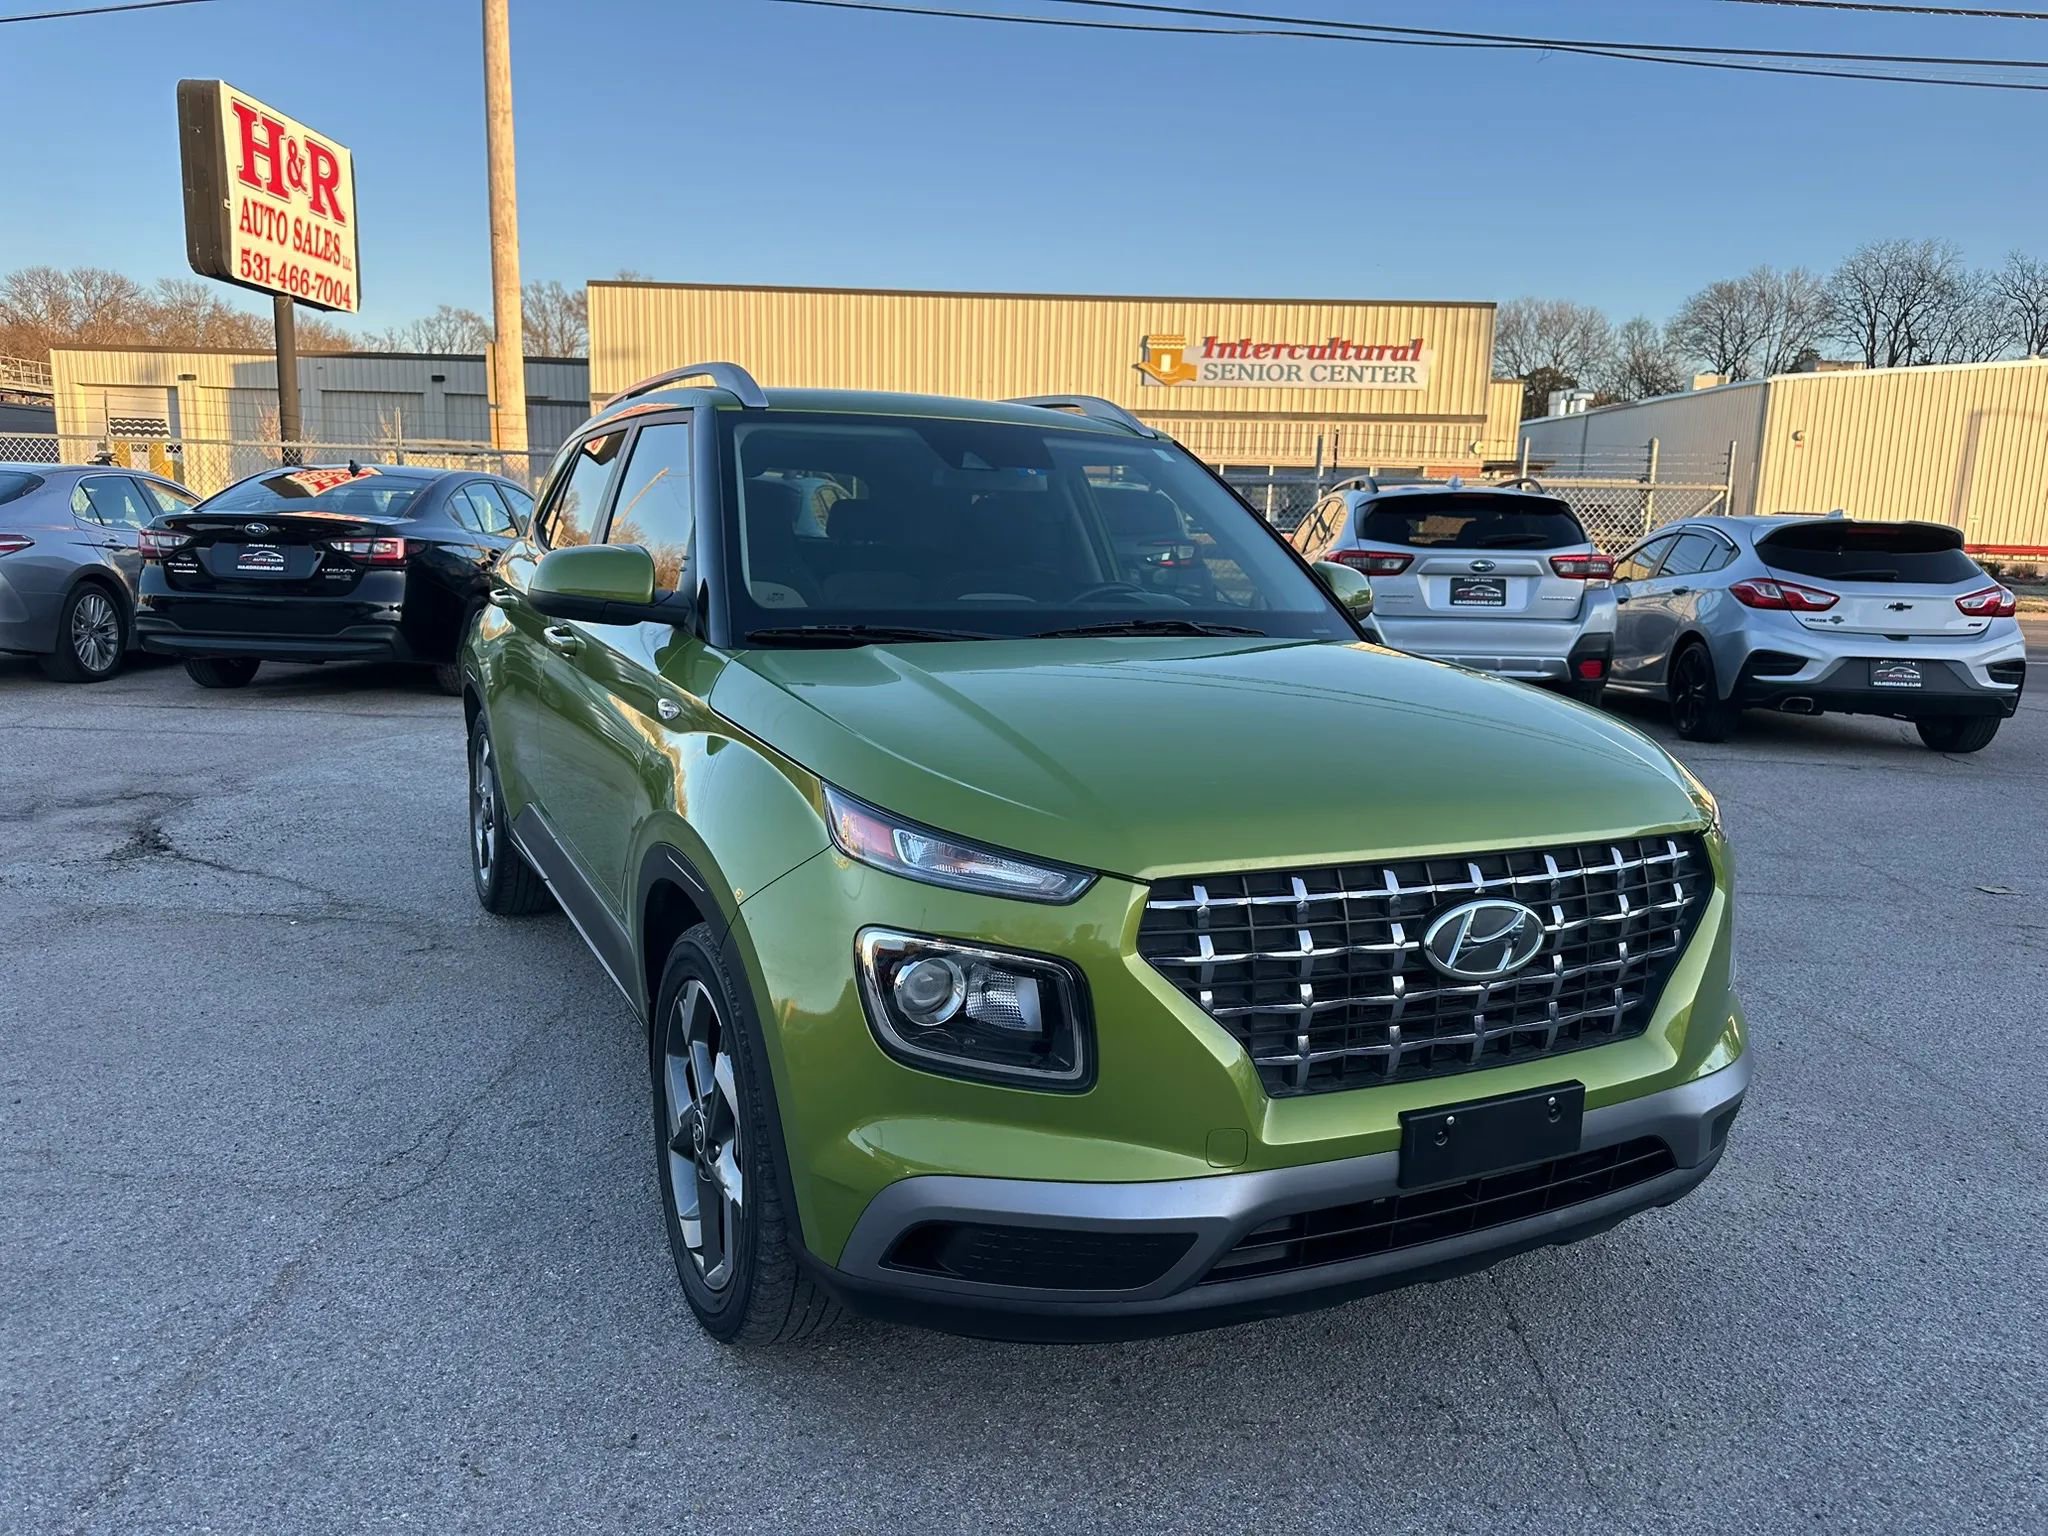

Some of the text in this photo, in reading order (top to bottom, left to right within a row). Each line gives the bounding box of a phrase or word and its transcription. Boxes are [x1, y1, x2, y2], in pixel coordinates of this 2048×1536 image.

[232, 99, 346, 225] H&R
[239, 198, 288, 246] AUTO
[293, 217, 341, 267] SALES
[240, 247, 351, 309] 531-466-7004
[1200, 335, 1424, 362] Intercultural
[1203, 362, 1417, 384] SENIOR CENTER
